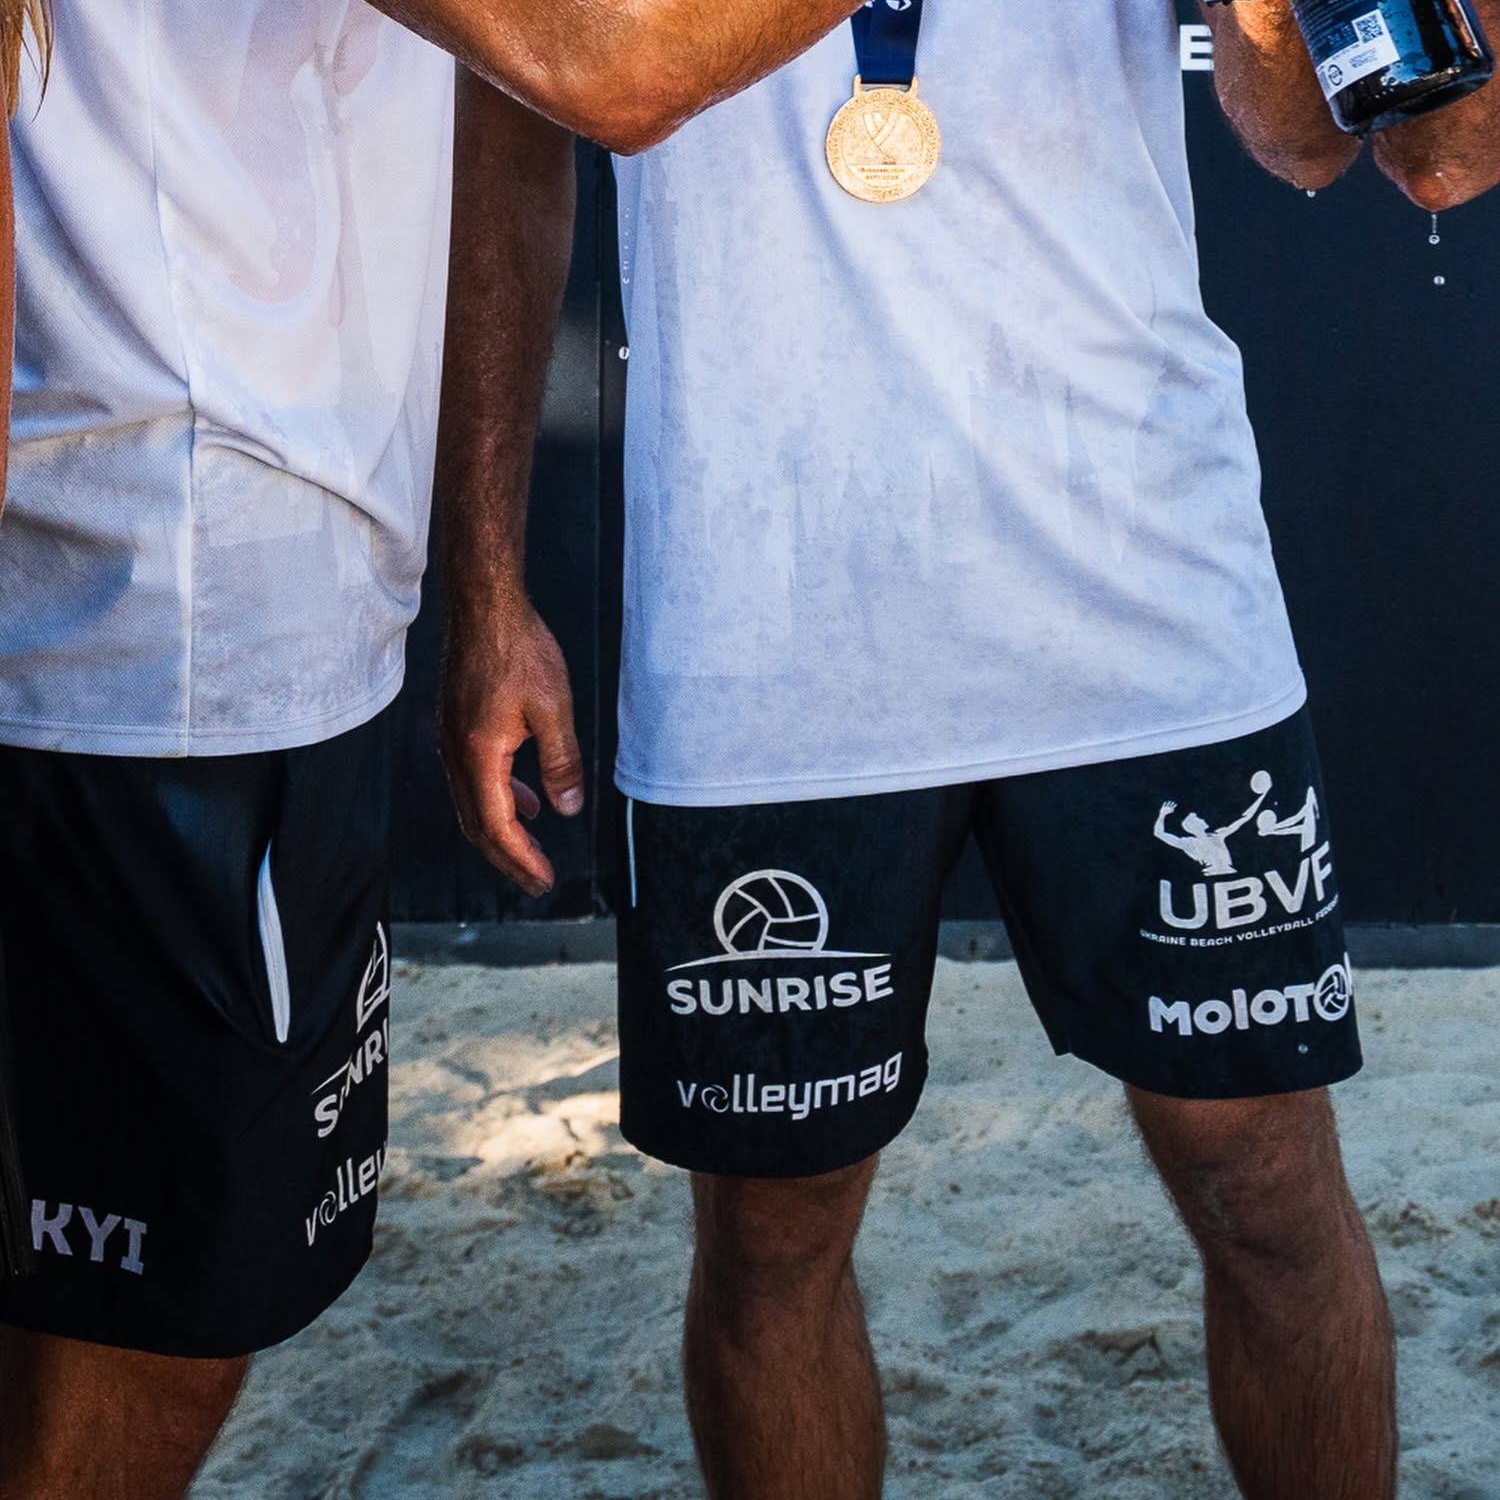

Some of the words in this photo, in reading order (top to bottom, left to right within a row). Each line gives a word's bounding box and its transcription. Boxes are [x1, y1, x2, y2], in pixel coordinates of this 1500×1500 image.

[1180, 25, 1215, 70] E
[1160, 841, 1333, 930] UBVF
[1190, 936, 1234, 948] BEACH
[1236, 917, 1314, 942] VOLLEYBALL
[667, 963, 895, 1016] SUNRISE
[676, 1052, 903, 1121] volleymag
[31, 1198, 148, 1276] KYI
